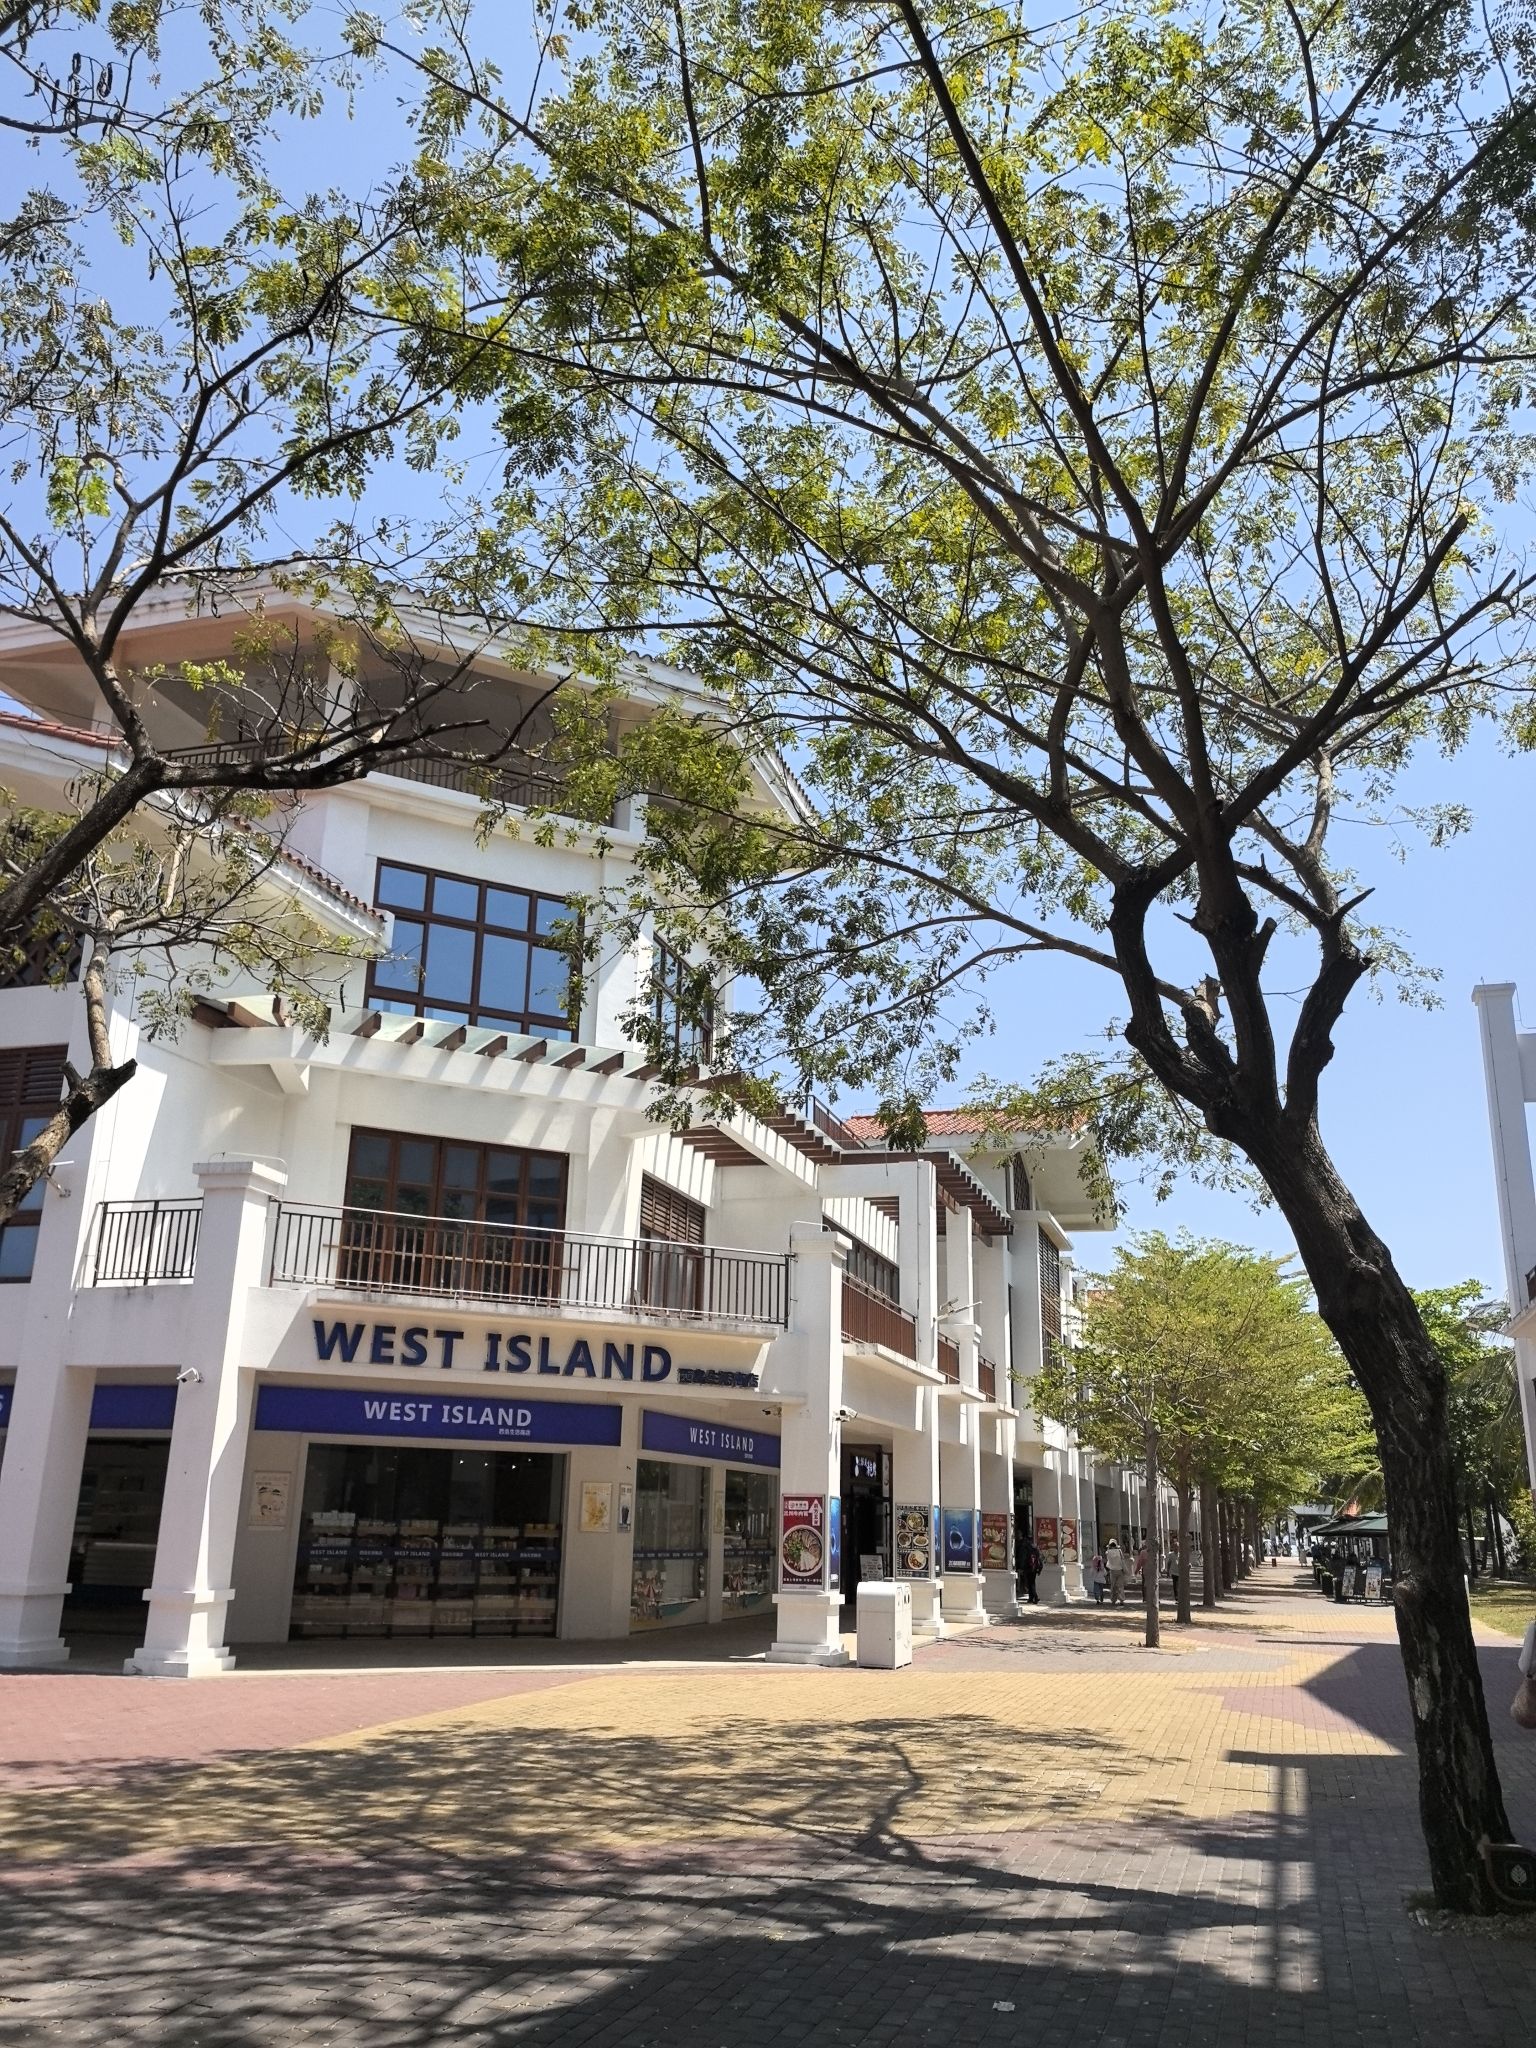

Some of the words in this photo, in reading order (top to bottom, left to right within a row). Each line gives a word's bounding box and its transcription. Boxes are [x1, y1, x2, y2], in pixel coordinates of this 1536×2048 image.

[313, 1319, 464, 1369] WEST
[484, 1332, 672, 1382] ISLAND
[363, 1400, 433, 1423] WEST
[441, 1404, 533, 1427] ISLAND
[689, 1427, 716, 1447] WEST
[720, 1433, 755, 1453] ISLAND
